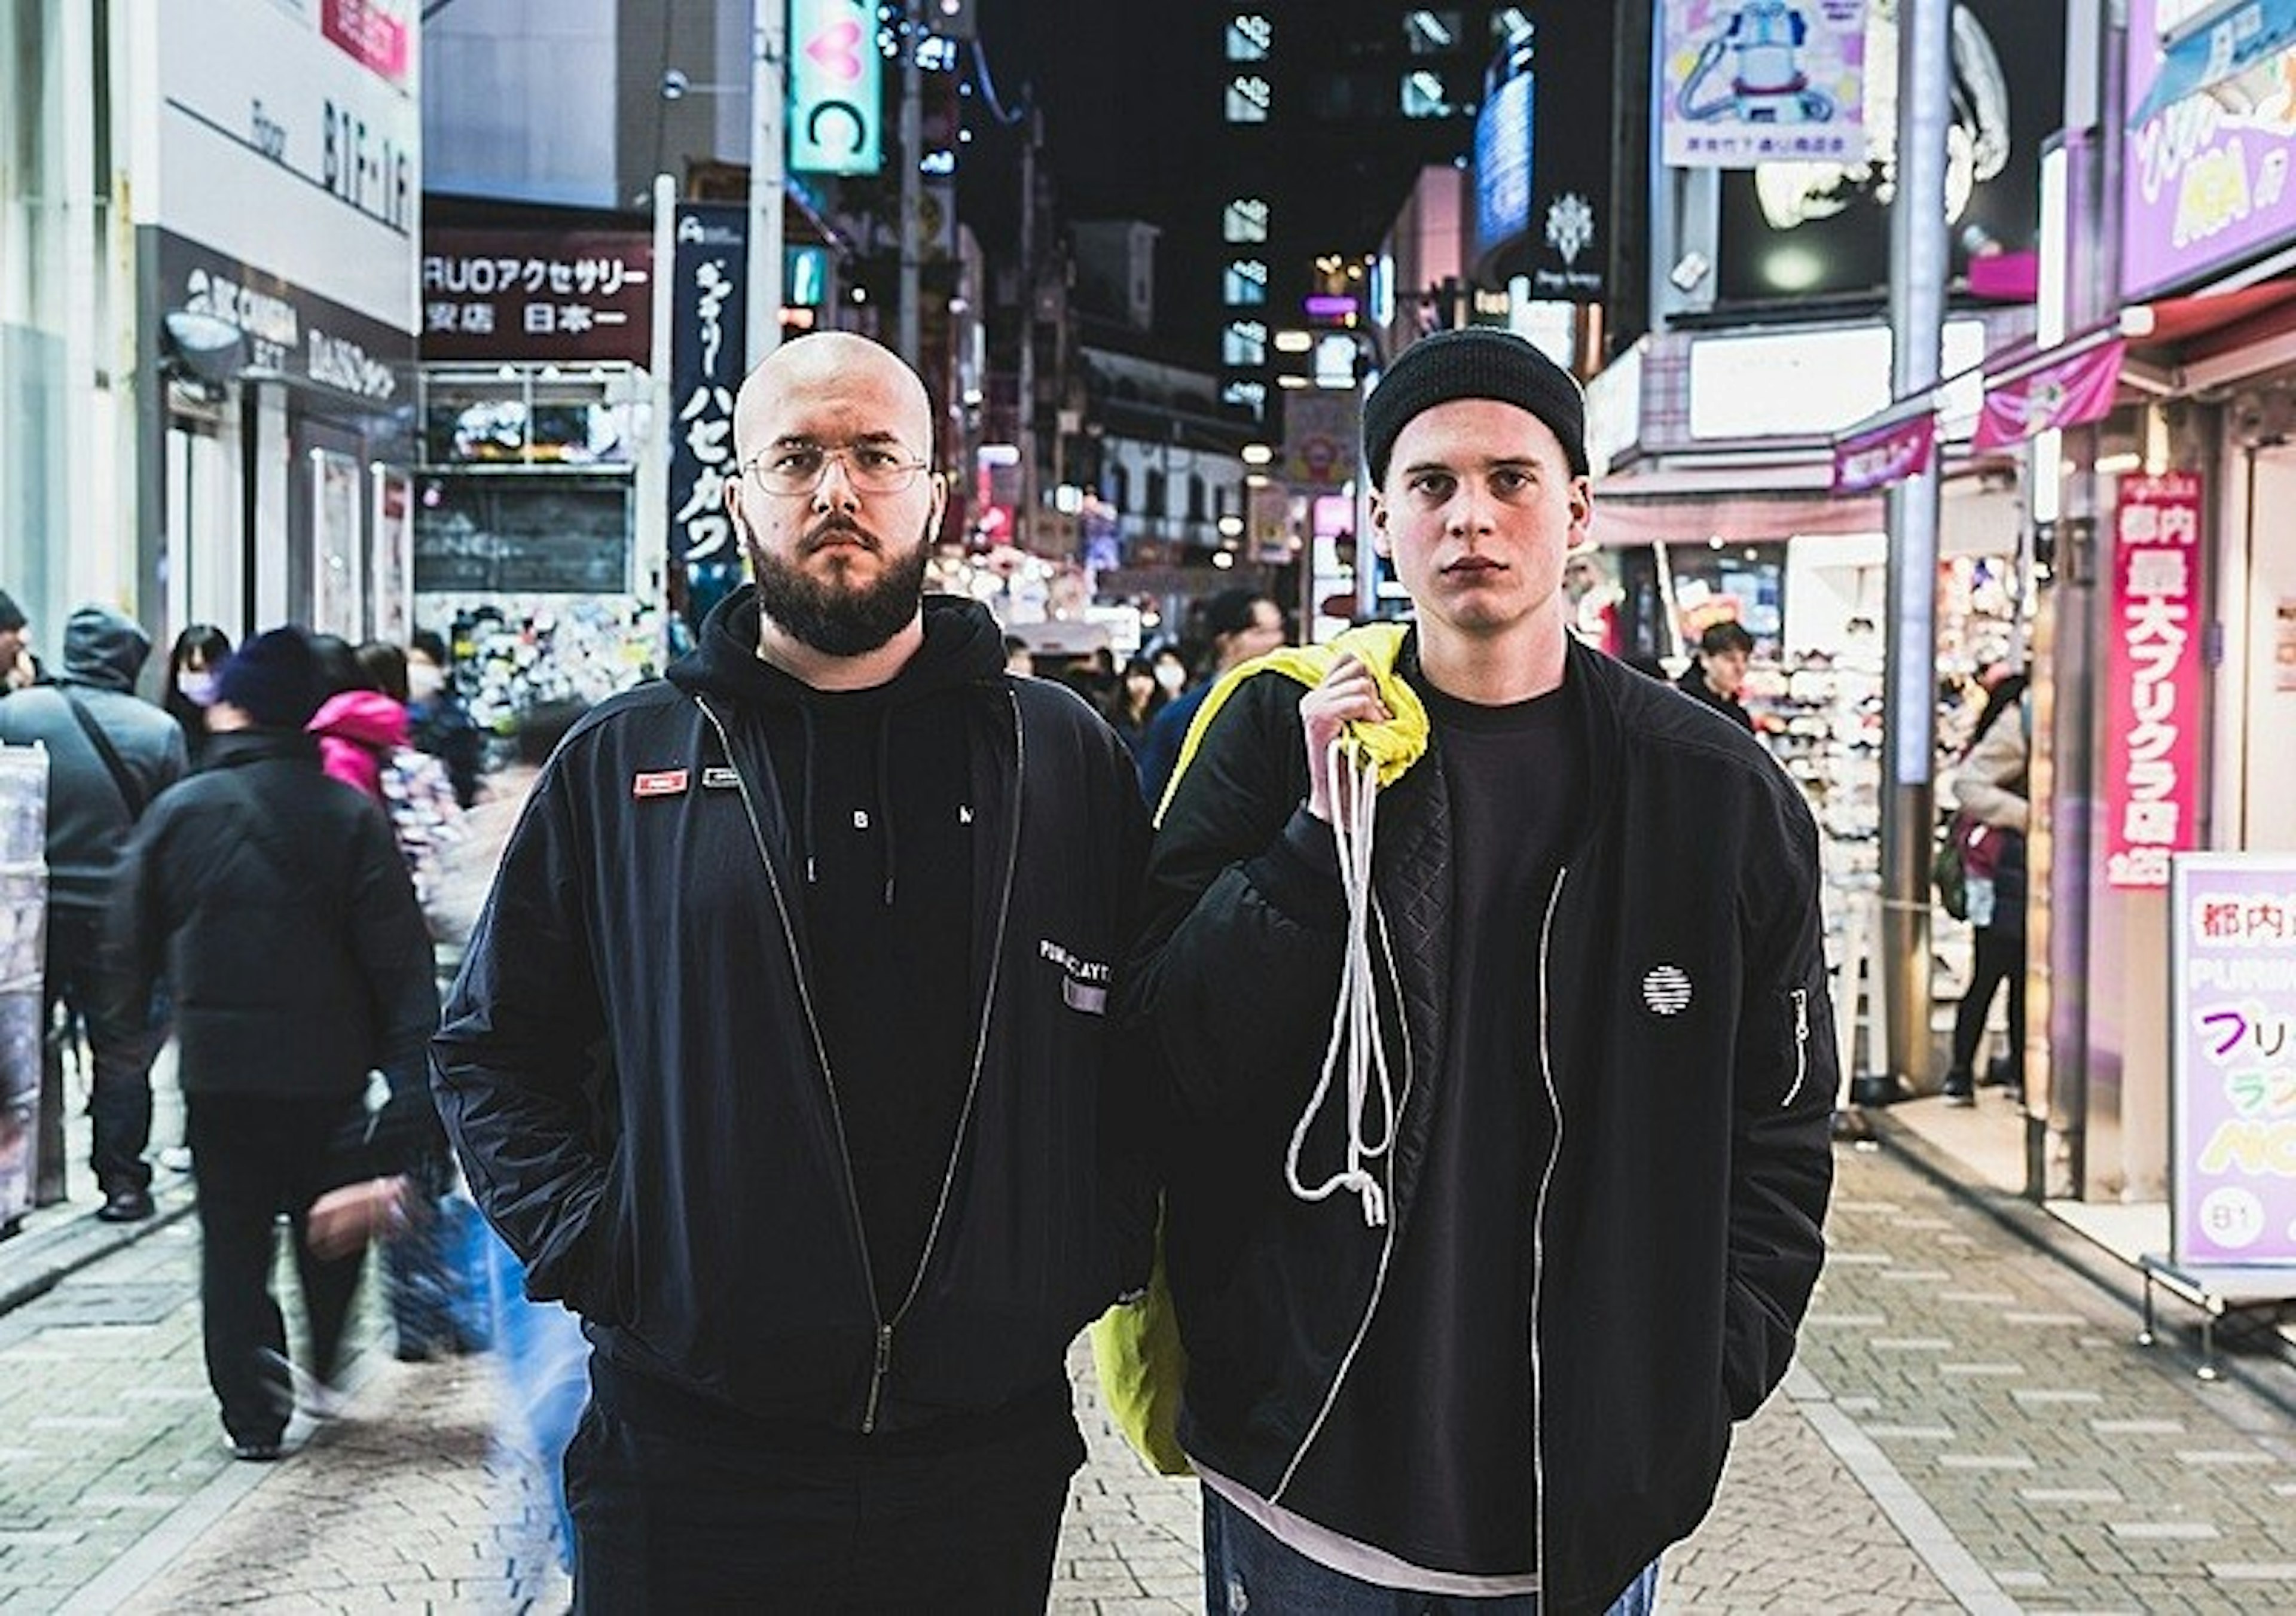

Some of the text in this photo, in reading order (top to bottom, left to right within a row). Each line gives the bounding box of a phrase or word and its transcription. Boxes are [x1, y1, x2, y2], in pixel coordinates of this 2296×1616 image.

[524, 302, 627, 334] 日本一
[2205, 903, 2296, 937] 都内
[2203, 1005, 2296, 1056] プリ
